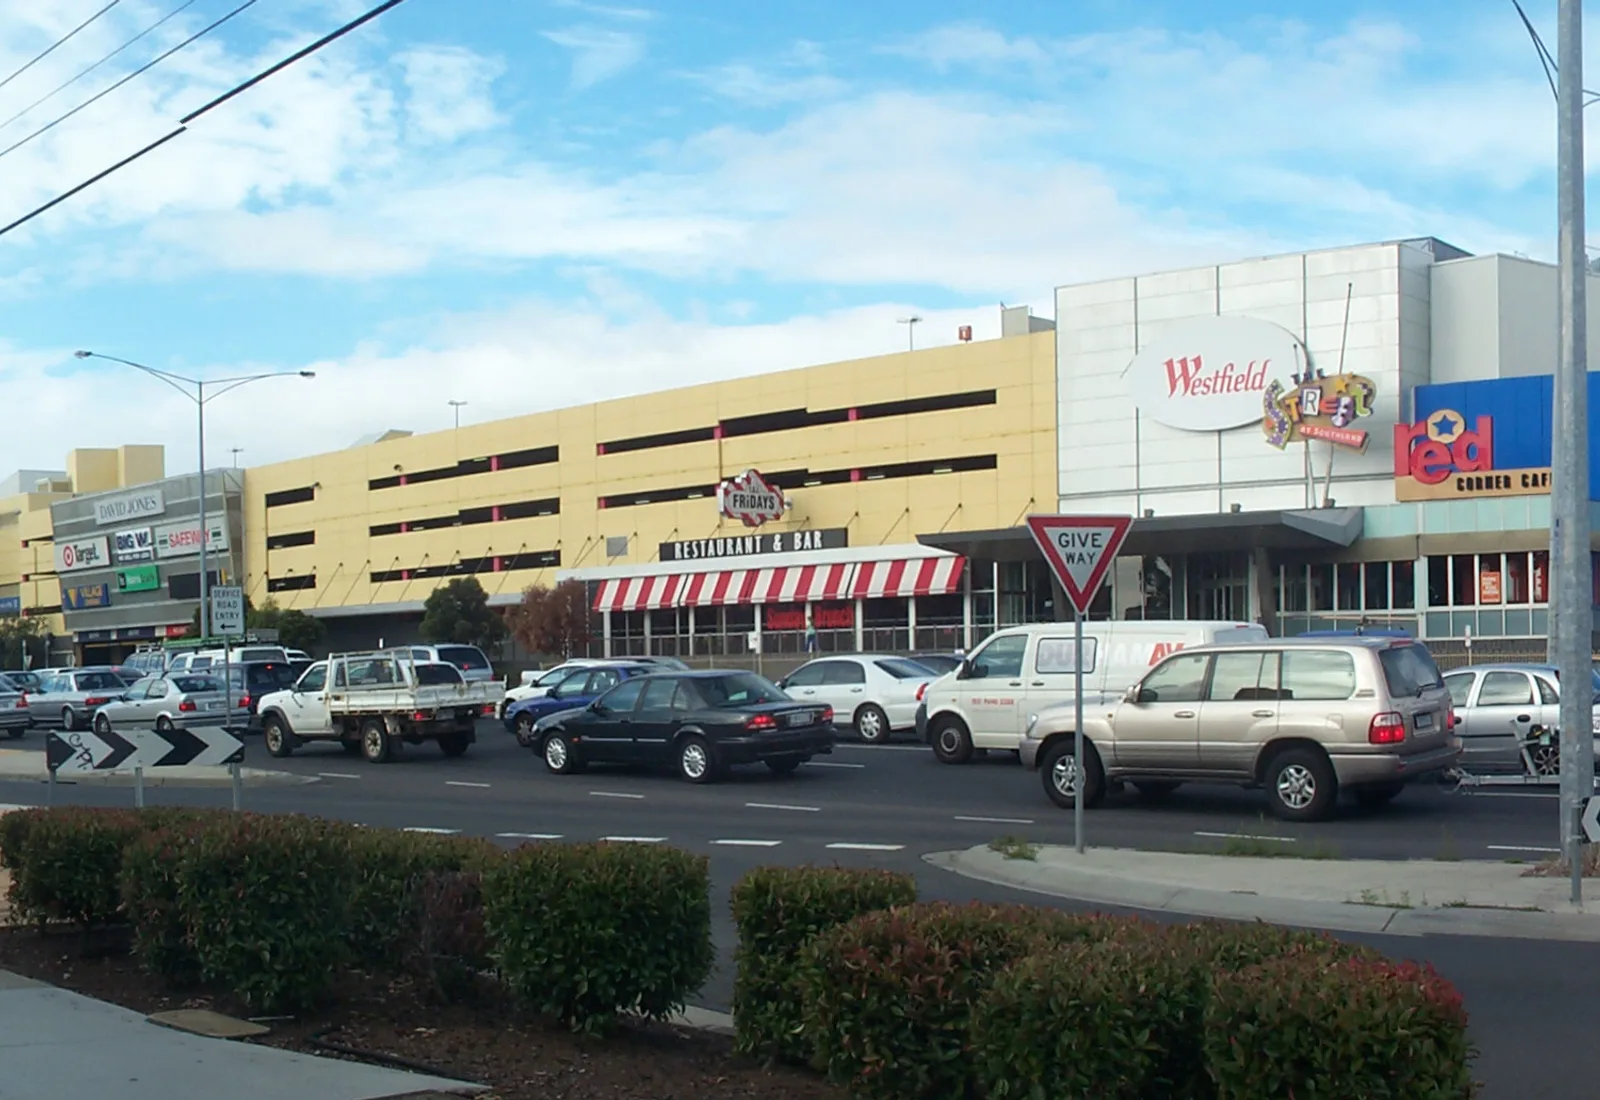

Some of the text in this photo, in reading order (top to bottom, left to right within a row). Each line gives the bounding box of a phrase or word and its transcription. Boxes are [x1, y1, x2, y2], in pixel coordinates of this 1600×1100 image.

[1162, 354, 1272, 399] Westfield
[1314, 426, 1363, 441] SOUTHLAND
[1394, 415, 1494, 485] red
[1457, 472, 1552, 491] CORNER CAF
[100, 496, 157, 519] DAVID JONES
[117, 531, 149, 550] BIG W
[674, 531, 822, 559] RESTAURANT & BAR
[1058, 532, 1102, 548] GIVE
[73, 543, 100, 565] Target
[1065, 552, 1096, 564] WAY
[213, 590, 240, 598] SERVICE
[217, 600, 238, 609] ROAD
[215, 612, 240, 620] ENTRY
